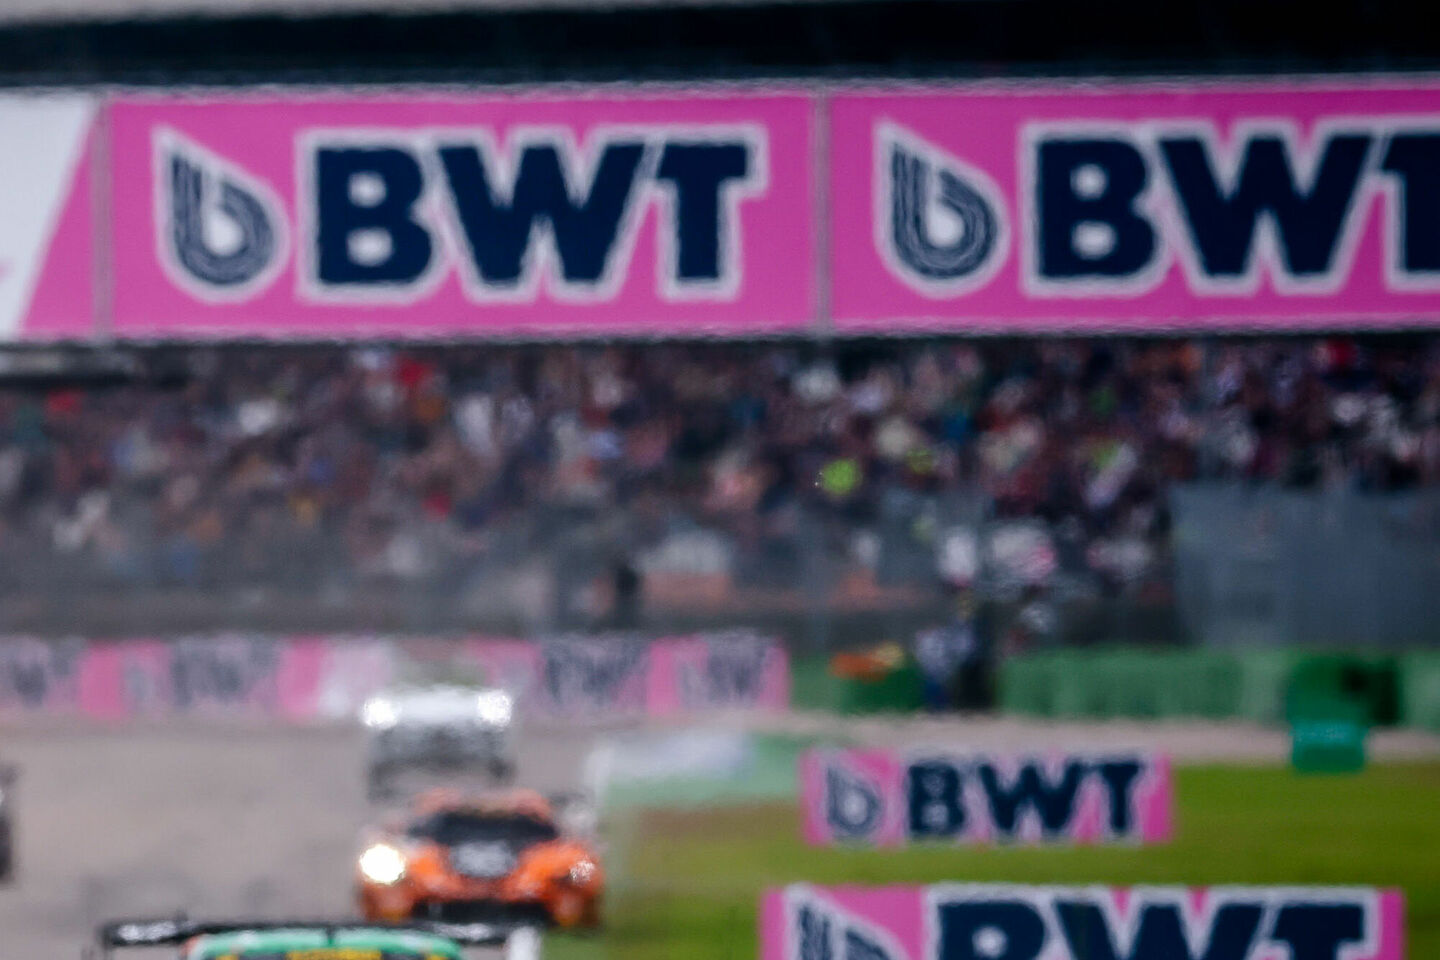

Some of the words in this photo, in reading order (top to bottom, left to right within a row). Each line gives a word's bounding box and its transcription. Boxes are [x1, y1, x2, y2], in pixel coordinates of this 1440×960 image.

[315, 142, 750, 284] BWT
[1037, 130, 1440, 277] BWT
[908, 760, 1144, 837] BWT
